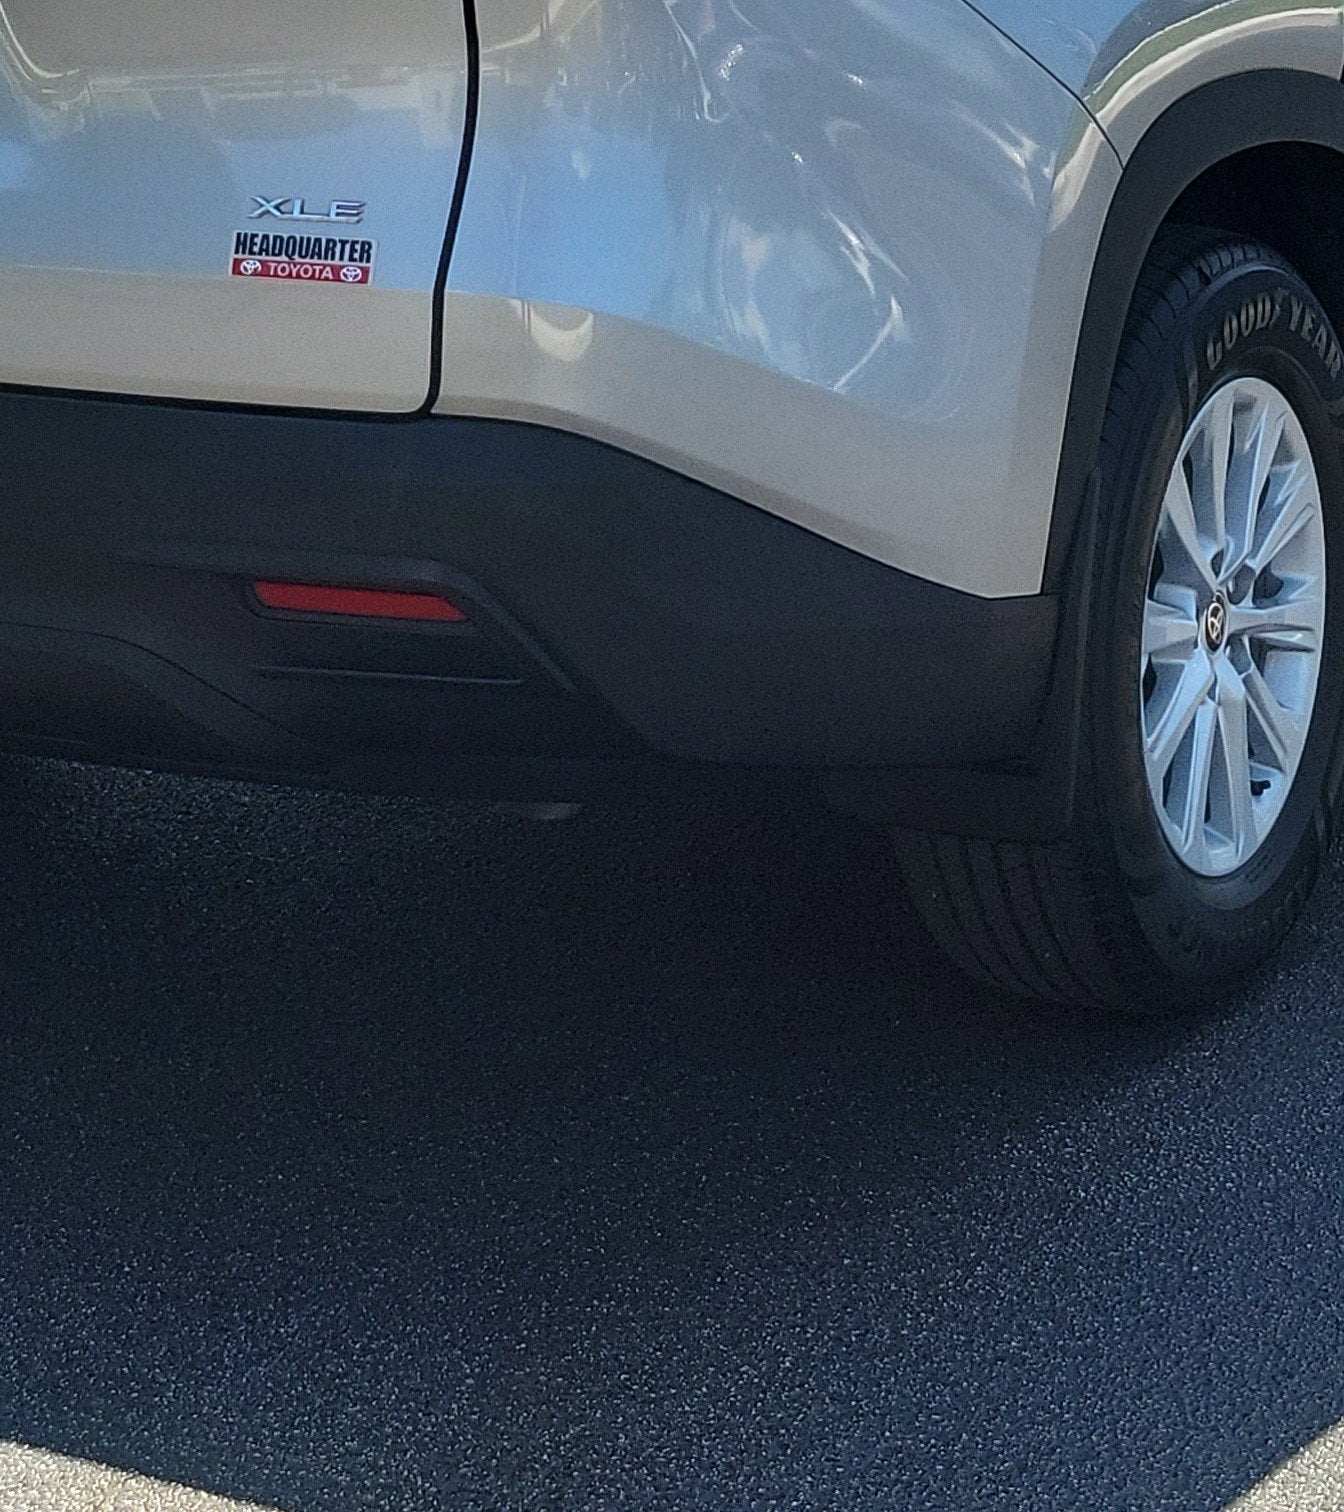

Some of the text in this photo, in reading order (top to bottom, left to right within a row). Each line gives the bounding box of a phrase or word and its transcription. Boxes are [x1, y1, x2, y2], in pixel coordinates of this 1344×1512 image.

[246, 195, 367, 225] XLE
[234, 231, 374, 264] HEADQUARTER
[267, 262, 334, 280] TOYOTA
